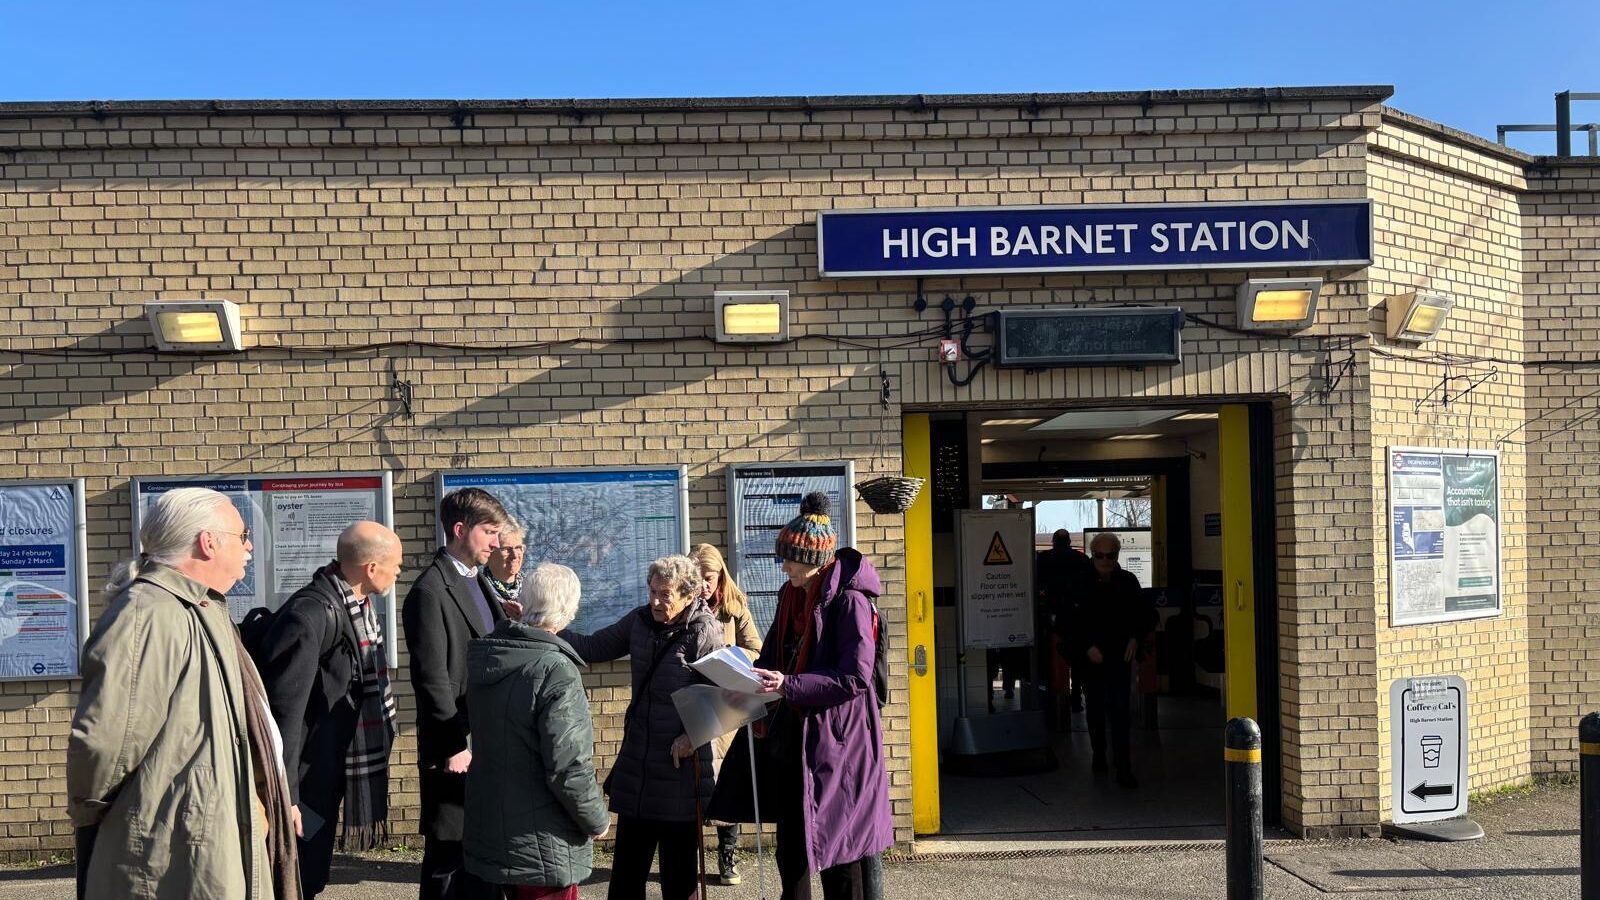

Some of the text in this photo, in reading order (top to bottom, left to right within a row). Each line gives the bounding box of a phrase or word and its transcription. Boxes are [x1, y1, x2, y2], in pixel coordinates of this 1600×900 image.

[882, 219, 1309, 259] HIGH BARNET STATION
[1447, 485, 1485, 497] Accountancy
[1447, 496, 1460, 506] that
[1461, 497, 1473, 506] isn't
[277, 502, 304, 511] oyster
[8, 527, 54, 536] closures
[21, 549, 52, 557] February
[1406, 703, 1432, 711] Coffee
[1438, 702, 1456, 710] Cal's
